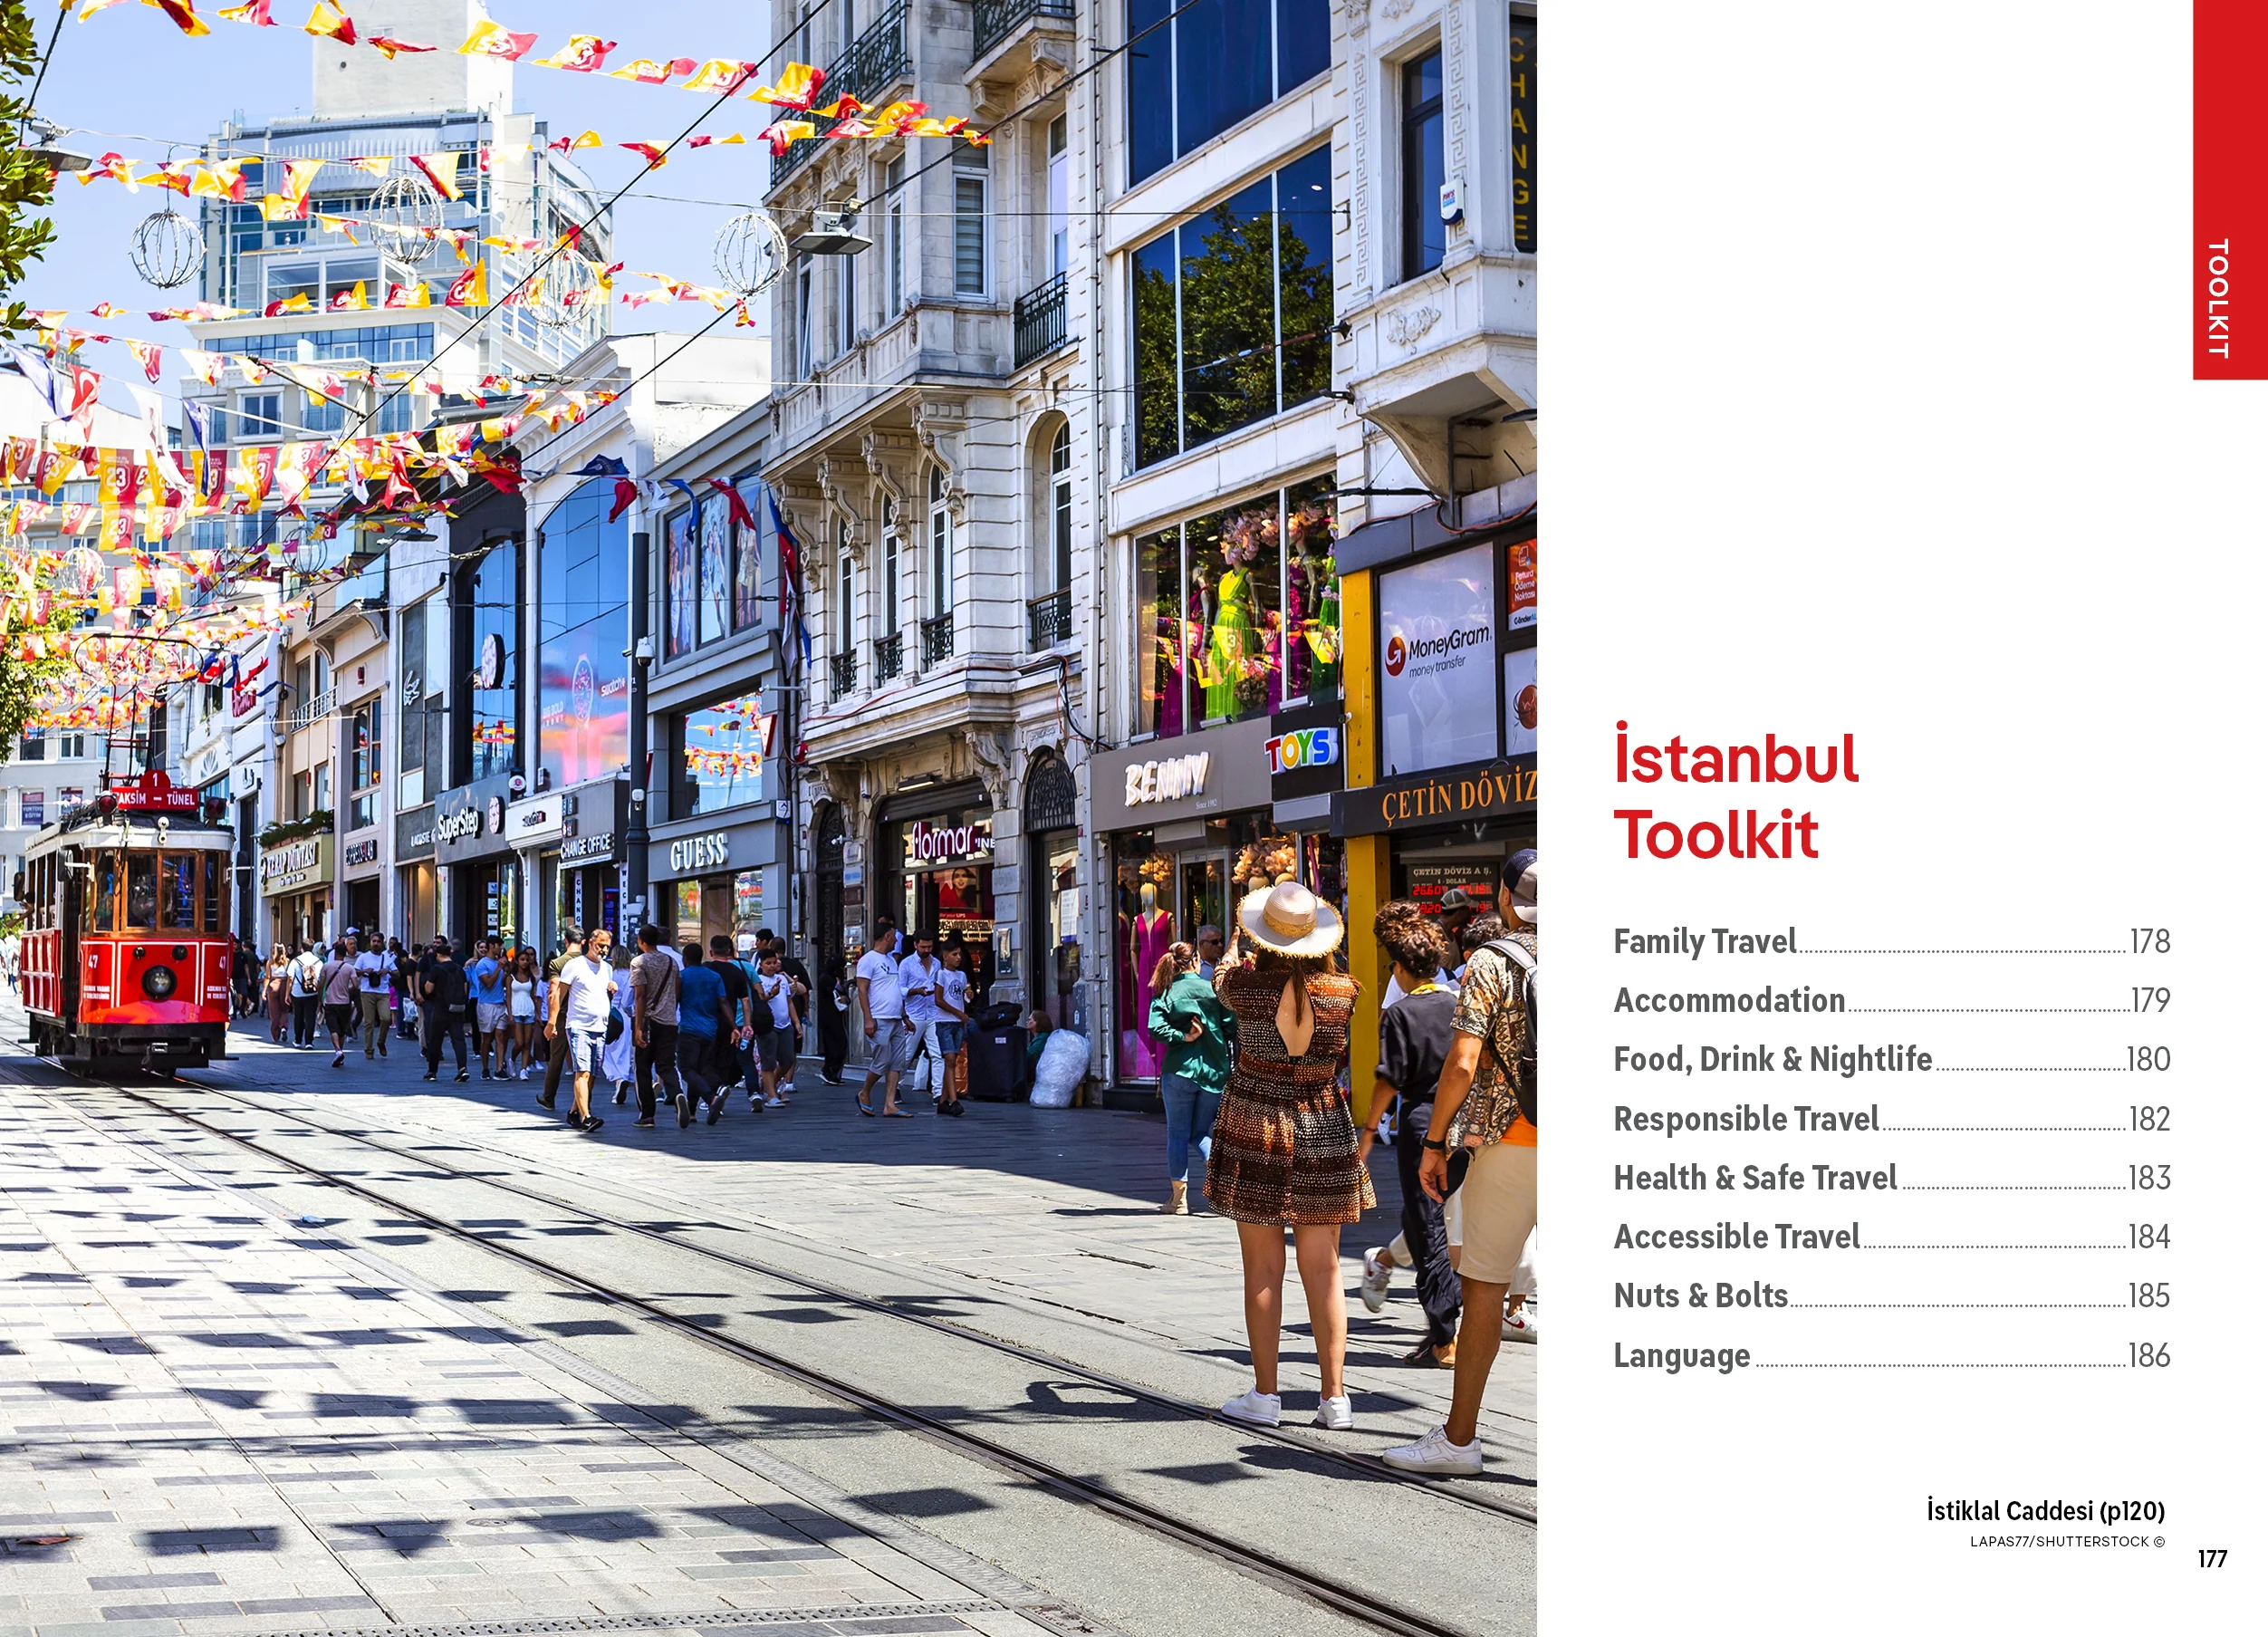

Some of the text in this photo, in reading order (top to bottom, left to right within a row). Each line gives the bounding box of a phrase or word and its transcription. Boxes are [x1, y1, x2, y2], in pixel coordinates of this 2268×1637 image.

[106, 467, 127, 487] 23
[108, 516, 127, 536] 23
[1408, 625, 1491, 660] MoneyGram
[1408, 655, 1466, 679] money transfer
[1264, 727, 1337, 775] TOYS
[153, 773, 159, 786] 1
[1124, 751, 1210, 807] BENNY
[167, 791, 195, 805] TÜNEL
[1382, 766, 1537, 828] ÇETİN DÖVİZ
[437, 808, 479, 844] SuperStep
[561, 833, 610, 859] CHANGE OFFICE
[670, 832, 728, 871] GUESS
[911, 821, 973, 860] flormar
[1413, 867, 1442, 876] ÇETİN
[1444, 866, 1472, 875] DÖVİZ
[88, 954, 99, 968] 47
